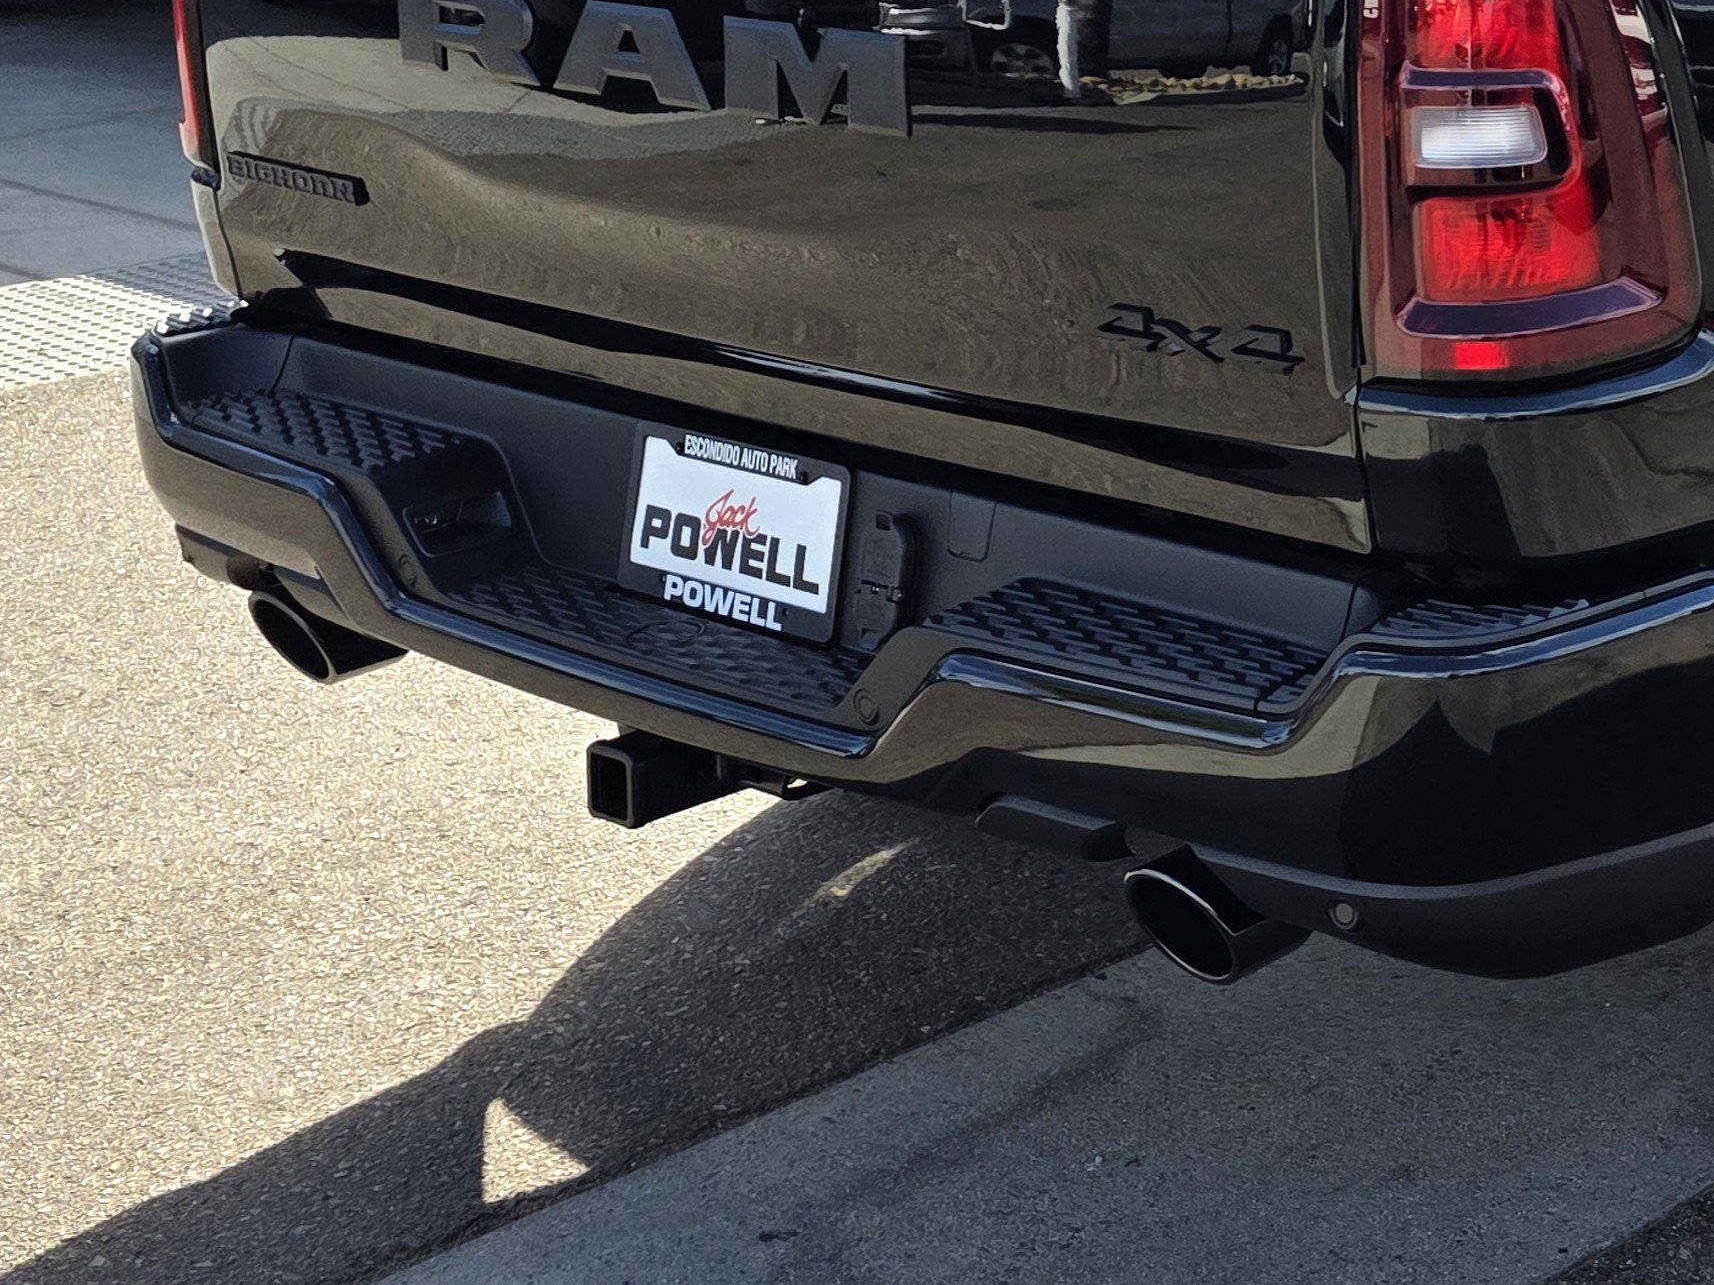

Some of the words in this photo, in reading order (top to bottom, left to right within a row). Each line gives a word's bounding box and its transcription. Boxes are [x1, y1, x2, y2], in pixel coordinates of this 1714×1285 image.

[227, 154, 356, 203] BIGHORN
[684, 434, 740, 466] ESCONDIDO
[741, 448, 768, 473] AUTO
[769, 454, 799, 480] PARK
[701, 488, 760, 547] Jack
[640, 503, 820, 596] POWELL
[663, 574, 782, 632] POWELL
